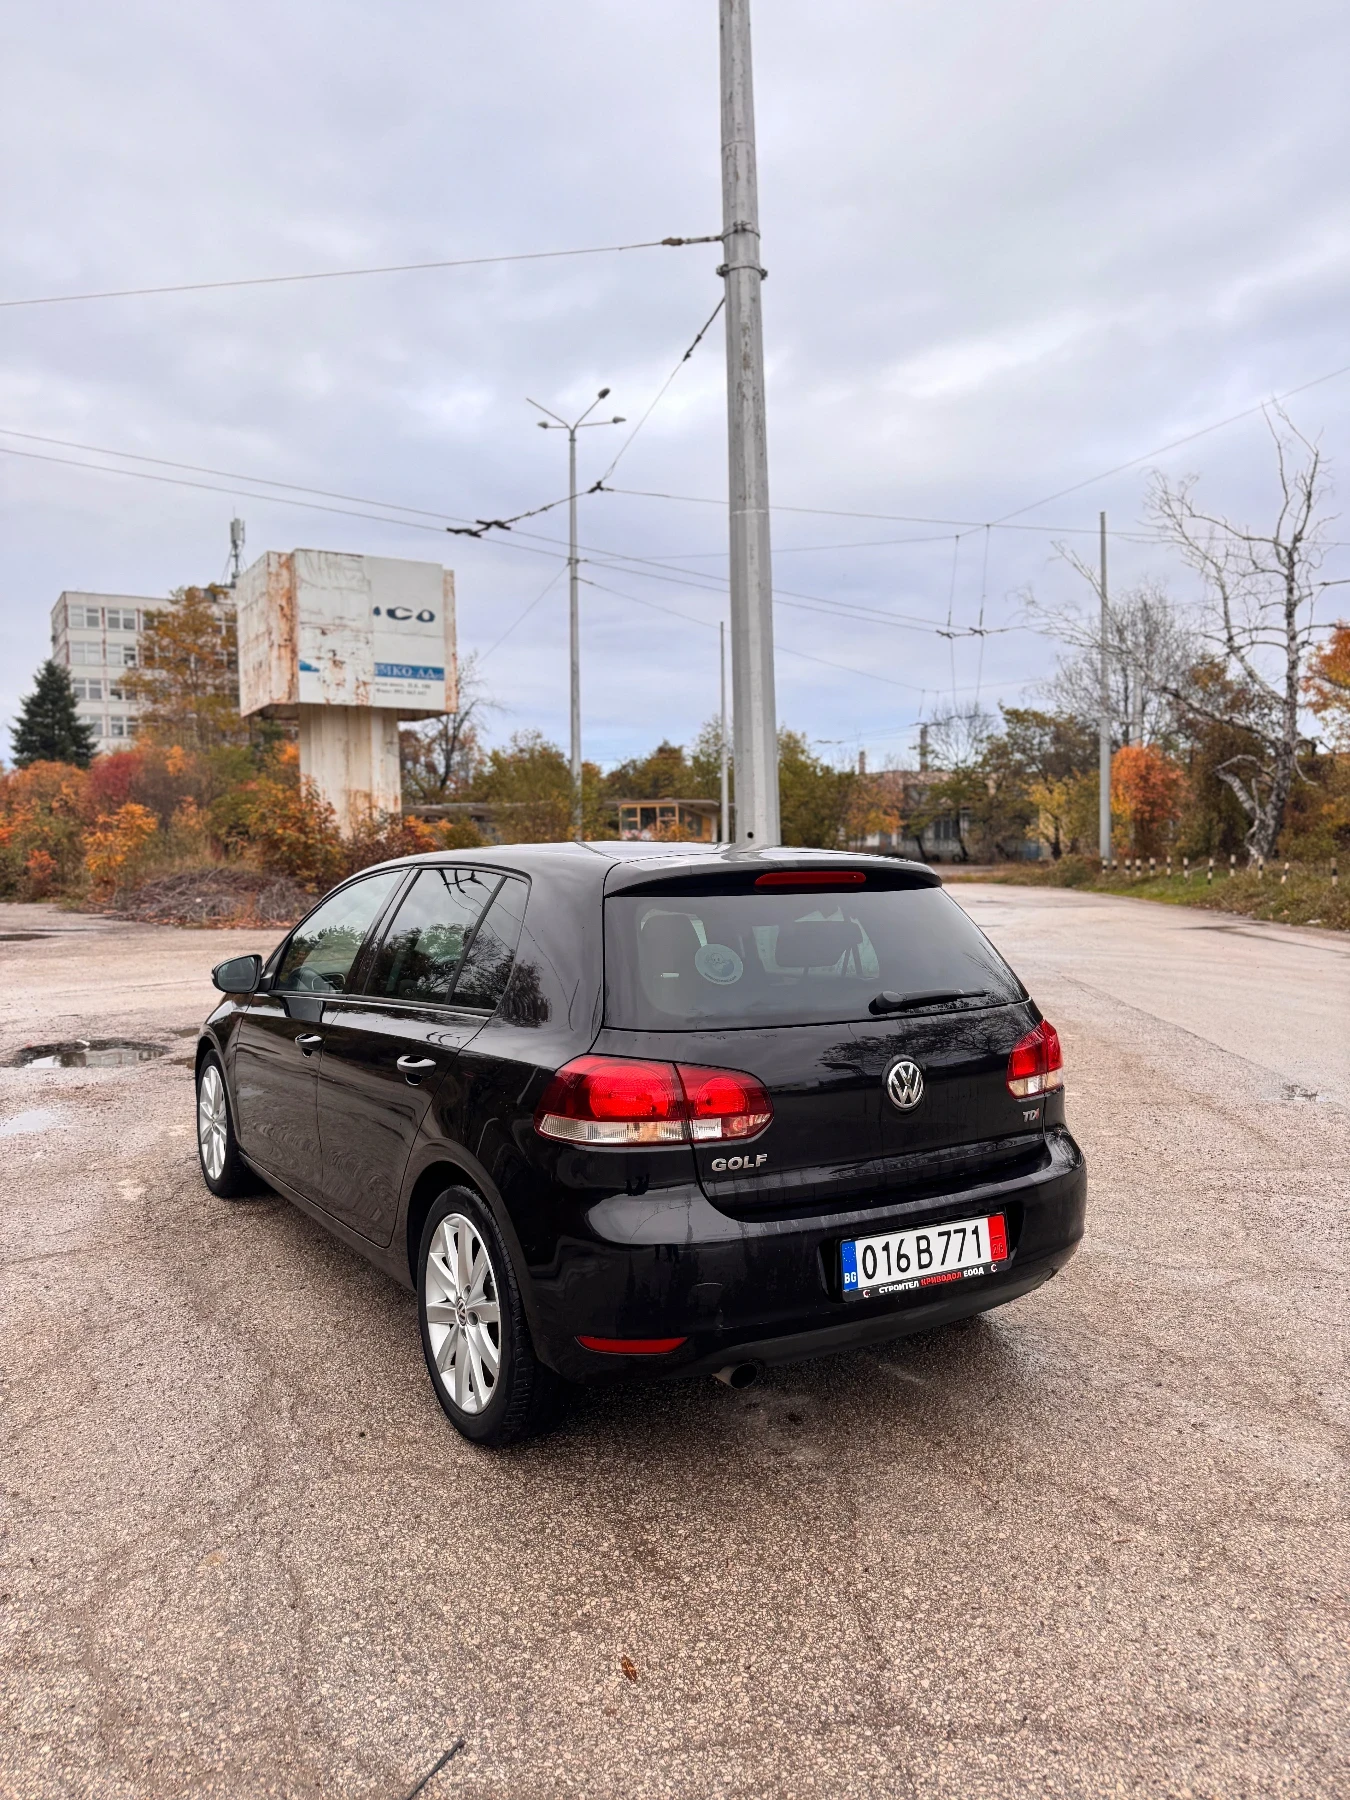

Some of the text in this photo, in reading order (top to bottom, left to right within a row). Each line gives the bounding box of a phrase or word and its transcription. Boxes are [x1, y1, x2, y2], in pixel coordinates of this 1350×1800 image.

[1022, 1108, 1040, 1122] TDI
[711, 1153, 768, 1172] GOLF
[862, 1225, 982, 1280] 016B771
[844, 1272, 857, 1284] BG
[878, 1266, 985, 1294] СТРОИТЕЛ КРИВОДОЛ ЕООД
